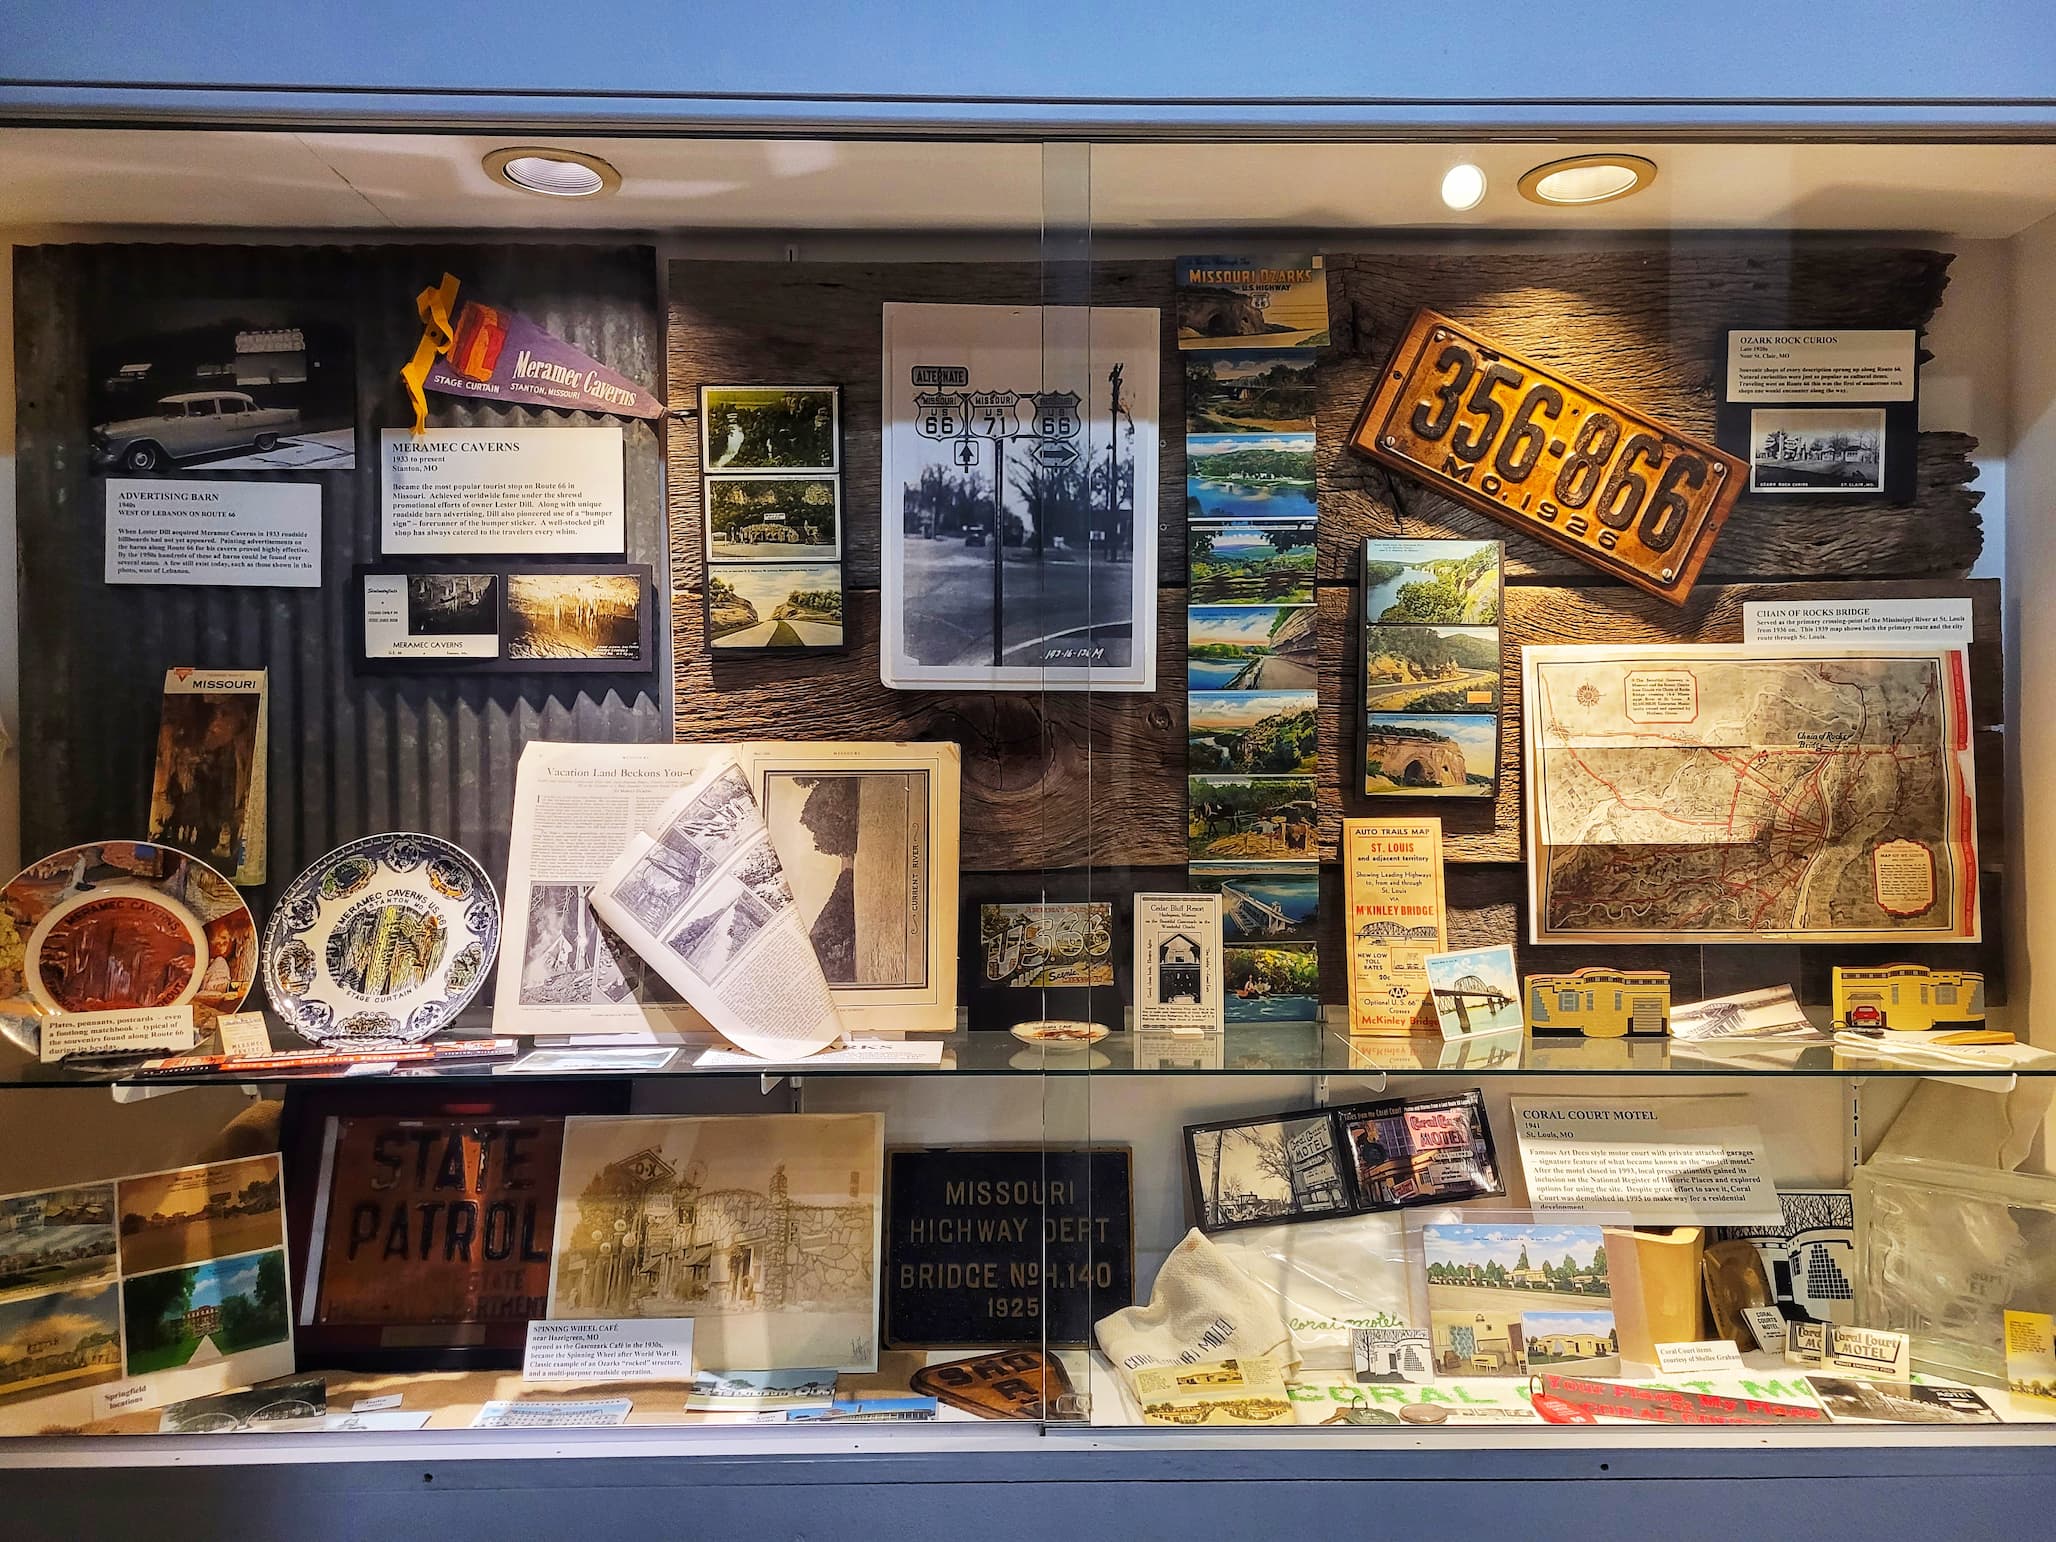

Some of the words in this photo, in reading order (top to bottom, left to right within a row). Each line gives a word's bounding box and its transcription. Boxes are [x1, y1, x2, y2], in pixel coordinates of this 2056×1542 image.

[1189, 269, 1256, 283] MISSOURI
[1260, 269, 1312, 283] OZARKS
[1803, 336, 1838, 344] CURIOS
[512, 350, 582, 387] Meramec
[583, 370, 637, 407] Caverns
[916, 370, 964, 383] ALTERNATE
[434, 375, 462, 388] STAGE
[466, 381, 500, 394] CURTAIN
[510, 382, 547, 395] STANTON,
[548, 389, 580, 400] MISSOURI
[922, 396, 957, 405] MISSOURI
[976, 395, 1013, 405] MISSOURI
[926, 417, 953, 434] 66
[984, 418, 1006, 435] 71
[1042, 418, 1070, 435] 66
[392, 443, 458, 452] MERAMEC
[461, 442, 520, 452] CAVERNS
[1411, 345, 1707, 553] 356-866
[419, 456, 445, 464] present
[118, 492, 188, 501] ADVERTISING
[191, 493, 219, 501] BARN
[1520, 494, 1620, 550] 1926
[1757, 609, 1786, 618] CHAIN
[1788, 609, 1800, 617] OF
[1803, 609, 1834, 617] ROCKS
[1836, 608, 1870, 616] BRIDGE
[392, 641, 428, 649] MERAMEC
[431, 641, 463, 649] CAVERNS
[547, 767, 589, 777] Vacation
[593, 768, 617, 777] Land
[621, 768, 661, 777] Beckons
[1371, 843, 1385, 852] ST.
[1388, 843, 1414, 852] LOUIS
[338, 892, 383, 925] MERAMEC
[387, 889, 428, 904] CAVERNS
[369, 898, 409, 909] STANTON
[1151, 904, 1168, 912] Cedar
[1401, 905, 1434, 915] BRIDGE
[65, 900, 124, 925] MERAMEC
[130, 902, 180, 931] CAVERNS
[346, 991, 370, 1002] STAGE
[375, 989, 412, 1003] CURTAIN
[1389, 989, 1408, 997] AAA
[50, 1021, 76, 1029] Plates,
[77, 1018, 115, 1028] pennants,
[117, 1016, 154, 1025] postcards
[1362, 1016, 1405, 1026] McKinley
[55, 1027, 89, 1038] footlong
[91, 1026, 134, 1034] matchbook
[143, 1023, 171, 1031] typical
[64, 1036, 102, 1045] souvenirs
[103, 1033, 126, 1042] found
[128, 1032, 149, 1042] along
[151, 1031, 173, 1039] Route
[1523, 1111, 1565, 1120] CORAL
[1568, 1111, 1610, 1120] COURT
[1614, 1111, 1658, 1120] MOTEL
[1537, 1131, 1559, 1139] Louis,
[1296, 1137, 1328, 1160] MOTEL
[371, 1127, 540, 1192] STATE
[945, 1180, 1074, 1206] MISSOURI
[347, 1201, 548, 1262] PATROL
[910, 1217, 1029, 1244] HIGHWAY
[1044, 1218, 1110, 1243] DEPT
[900, 1263, 998, 1289] BRIDGE
[987, 1297, 1039, 1317] 1925
[599, 1323, 618, 1332] CAFÉ
[1833, 1329, 1862, 1343] Coral
[1865, 1333, 1896, 1348] Court
[1842, 1344, 1886, 1359] MOTEL
[105, 1385, 147, 1401] Springfield
[1546, 1374, 1607, 1396] Your
[1700, 1394, 1737, 1411] My
[1744, 1400, 1820, 1420] Place
[109, 1396, 143, 1409] locations
